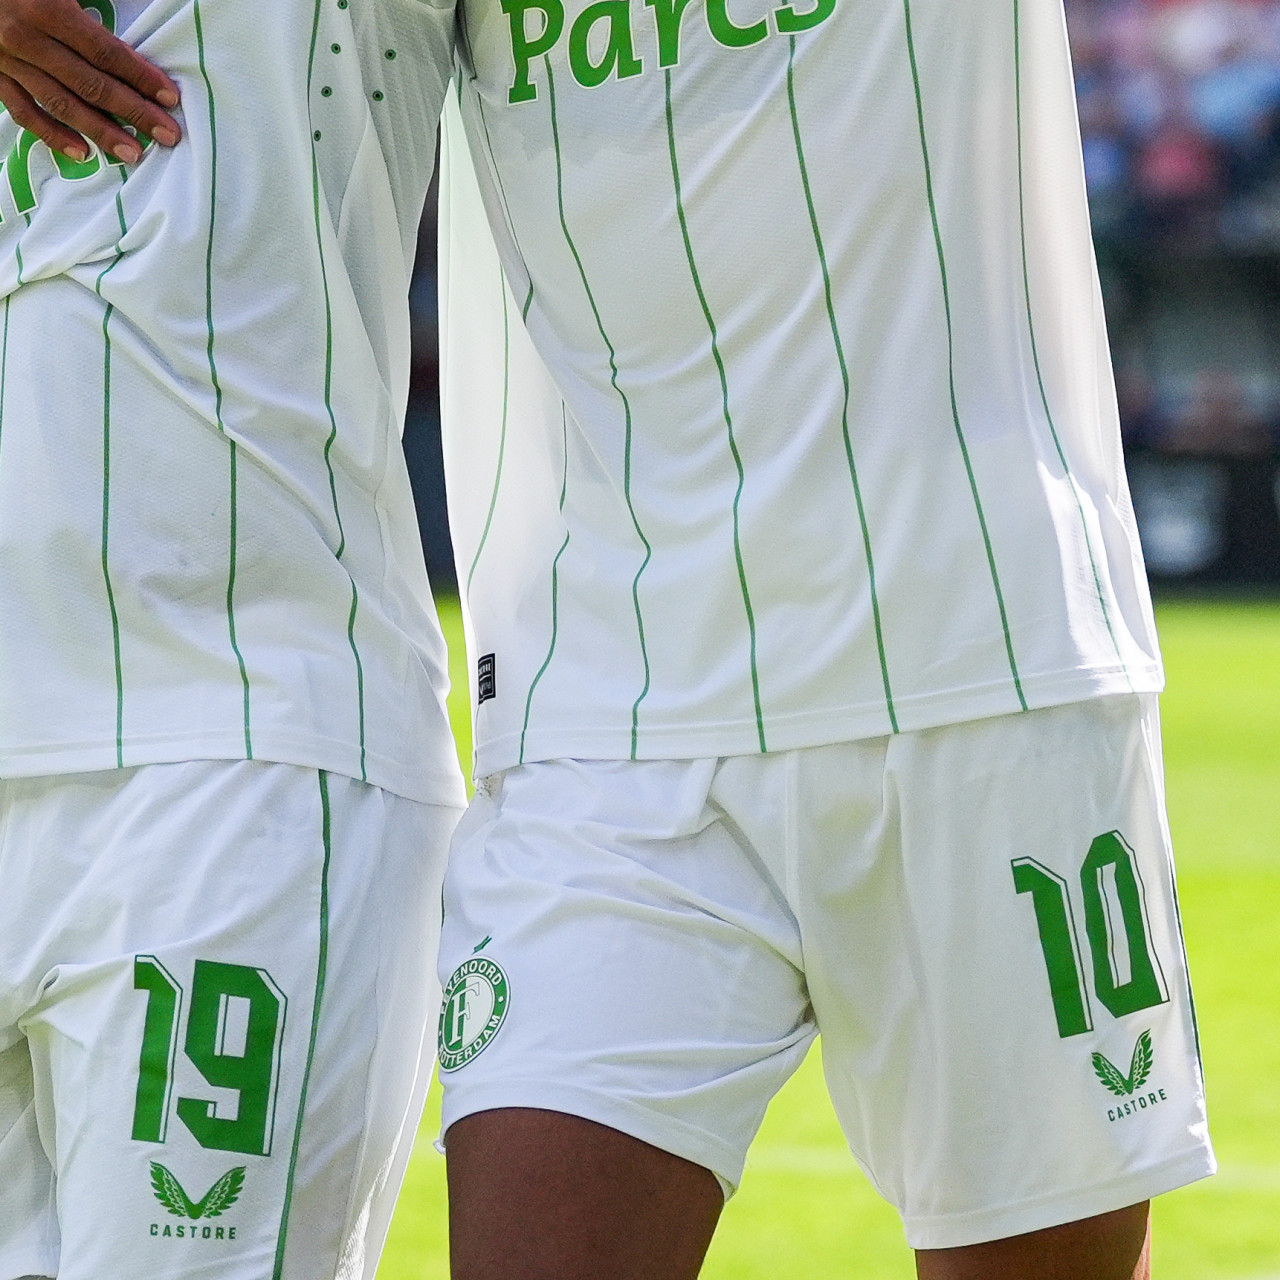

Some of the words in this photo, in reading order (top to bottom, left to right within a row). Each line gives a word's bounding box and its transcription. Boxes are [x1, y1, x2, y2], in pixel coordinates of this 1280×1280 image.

[1010, 828, 1170, 1038] 10
[131, 954, 288, 1157] 19
[1107, 1087, 1168, 1122] CASTORE
[149, 1223, 237, 1240] CASTORE
